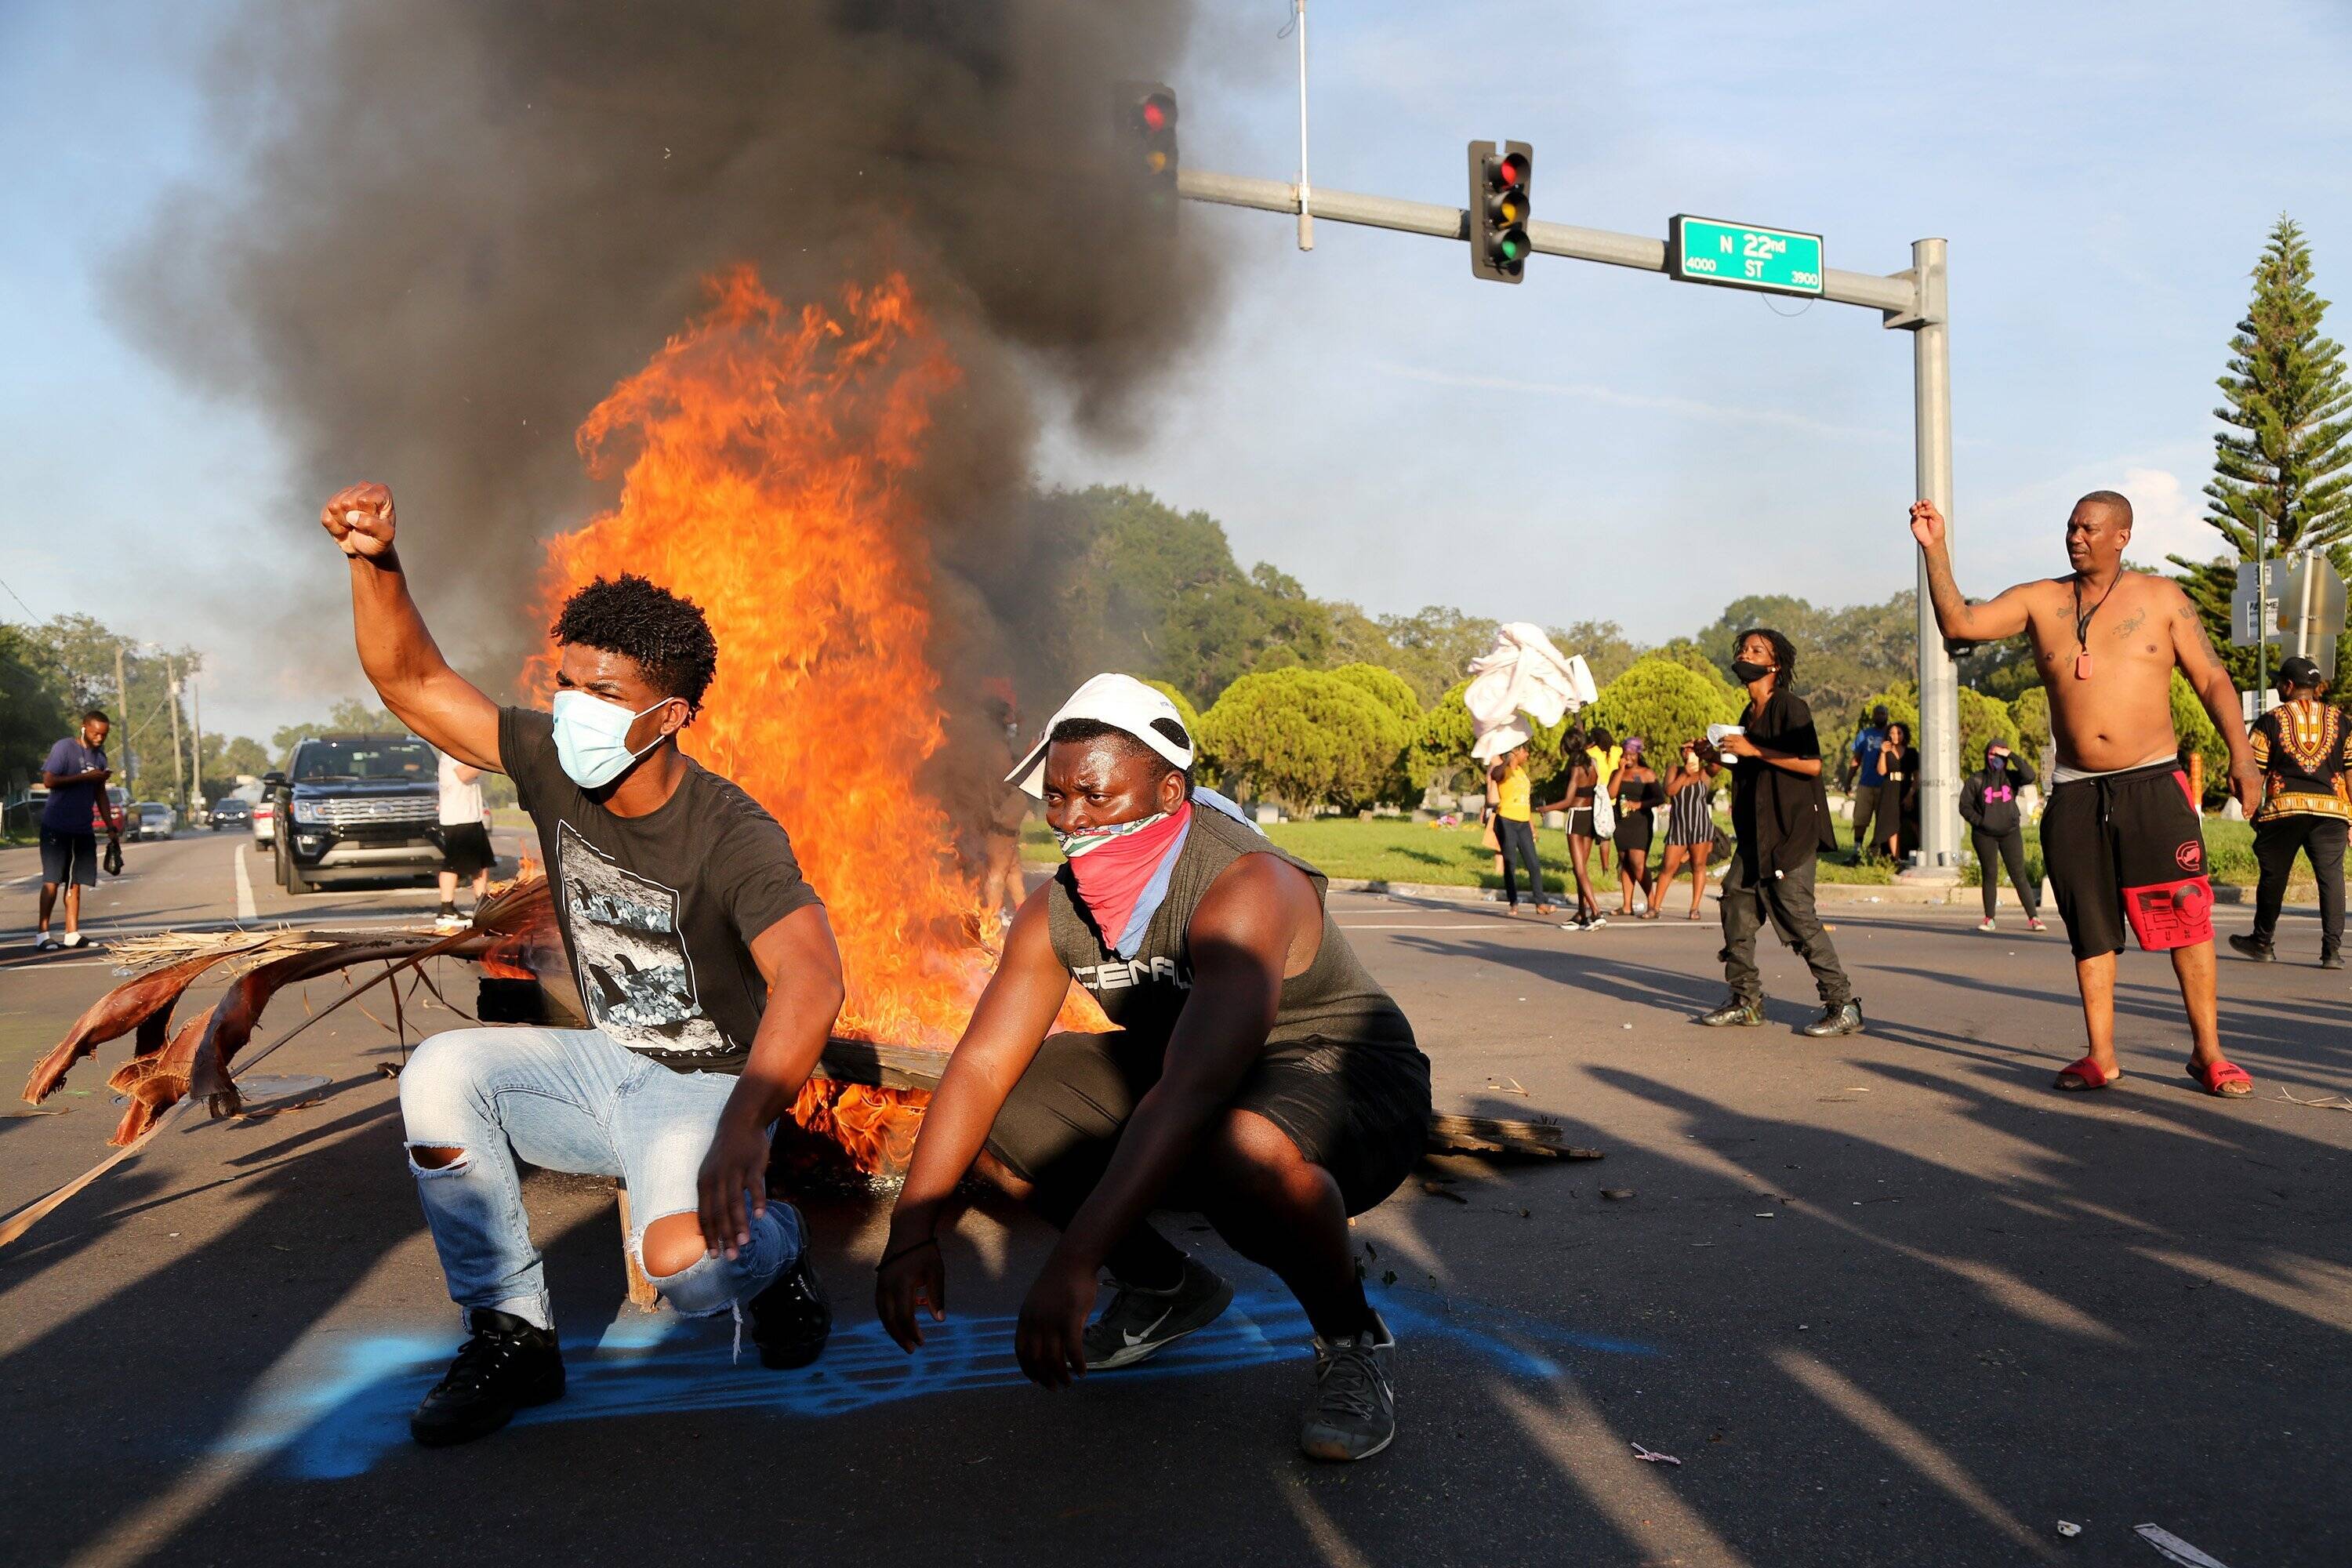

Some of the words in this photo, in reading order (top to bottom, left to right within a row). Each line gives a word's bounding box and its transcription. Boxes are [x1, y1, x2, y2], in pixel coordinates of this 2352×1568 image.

[1720, 235, 1733, 254] N
[1743, 233, 1786, 260] 22nd
[1686, 256, 1716, 272] 4000
[1744, 260, 1764, 278] ST
[1791, 270, 1818, 286] 3900
